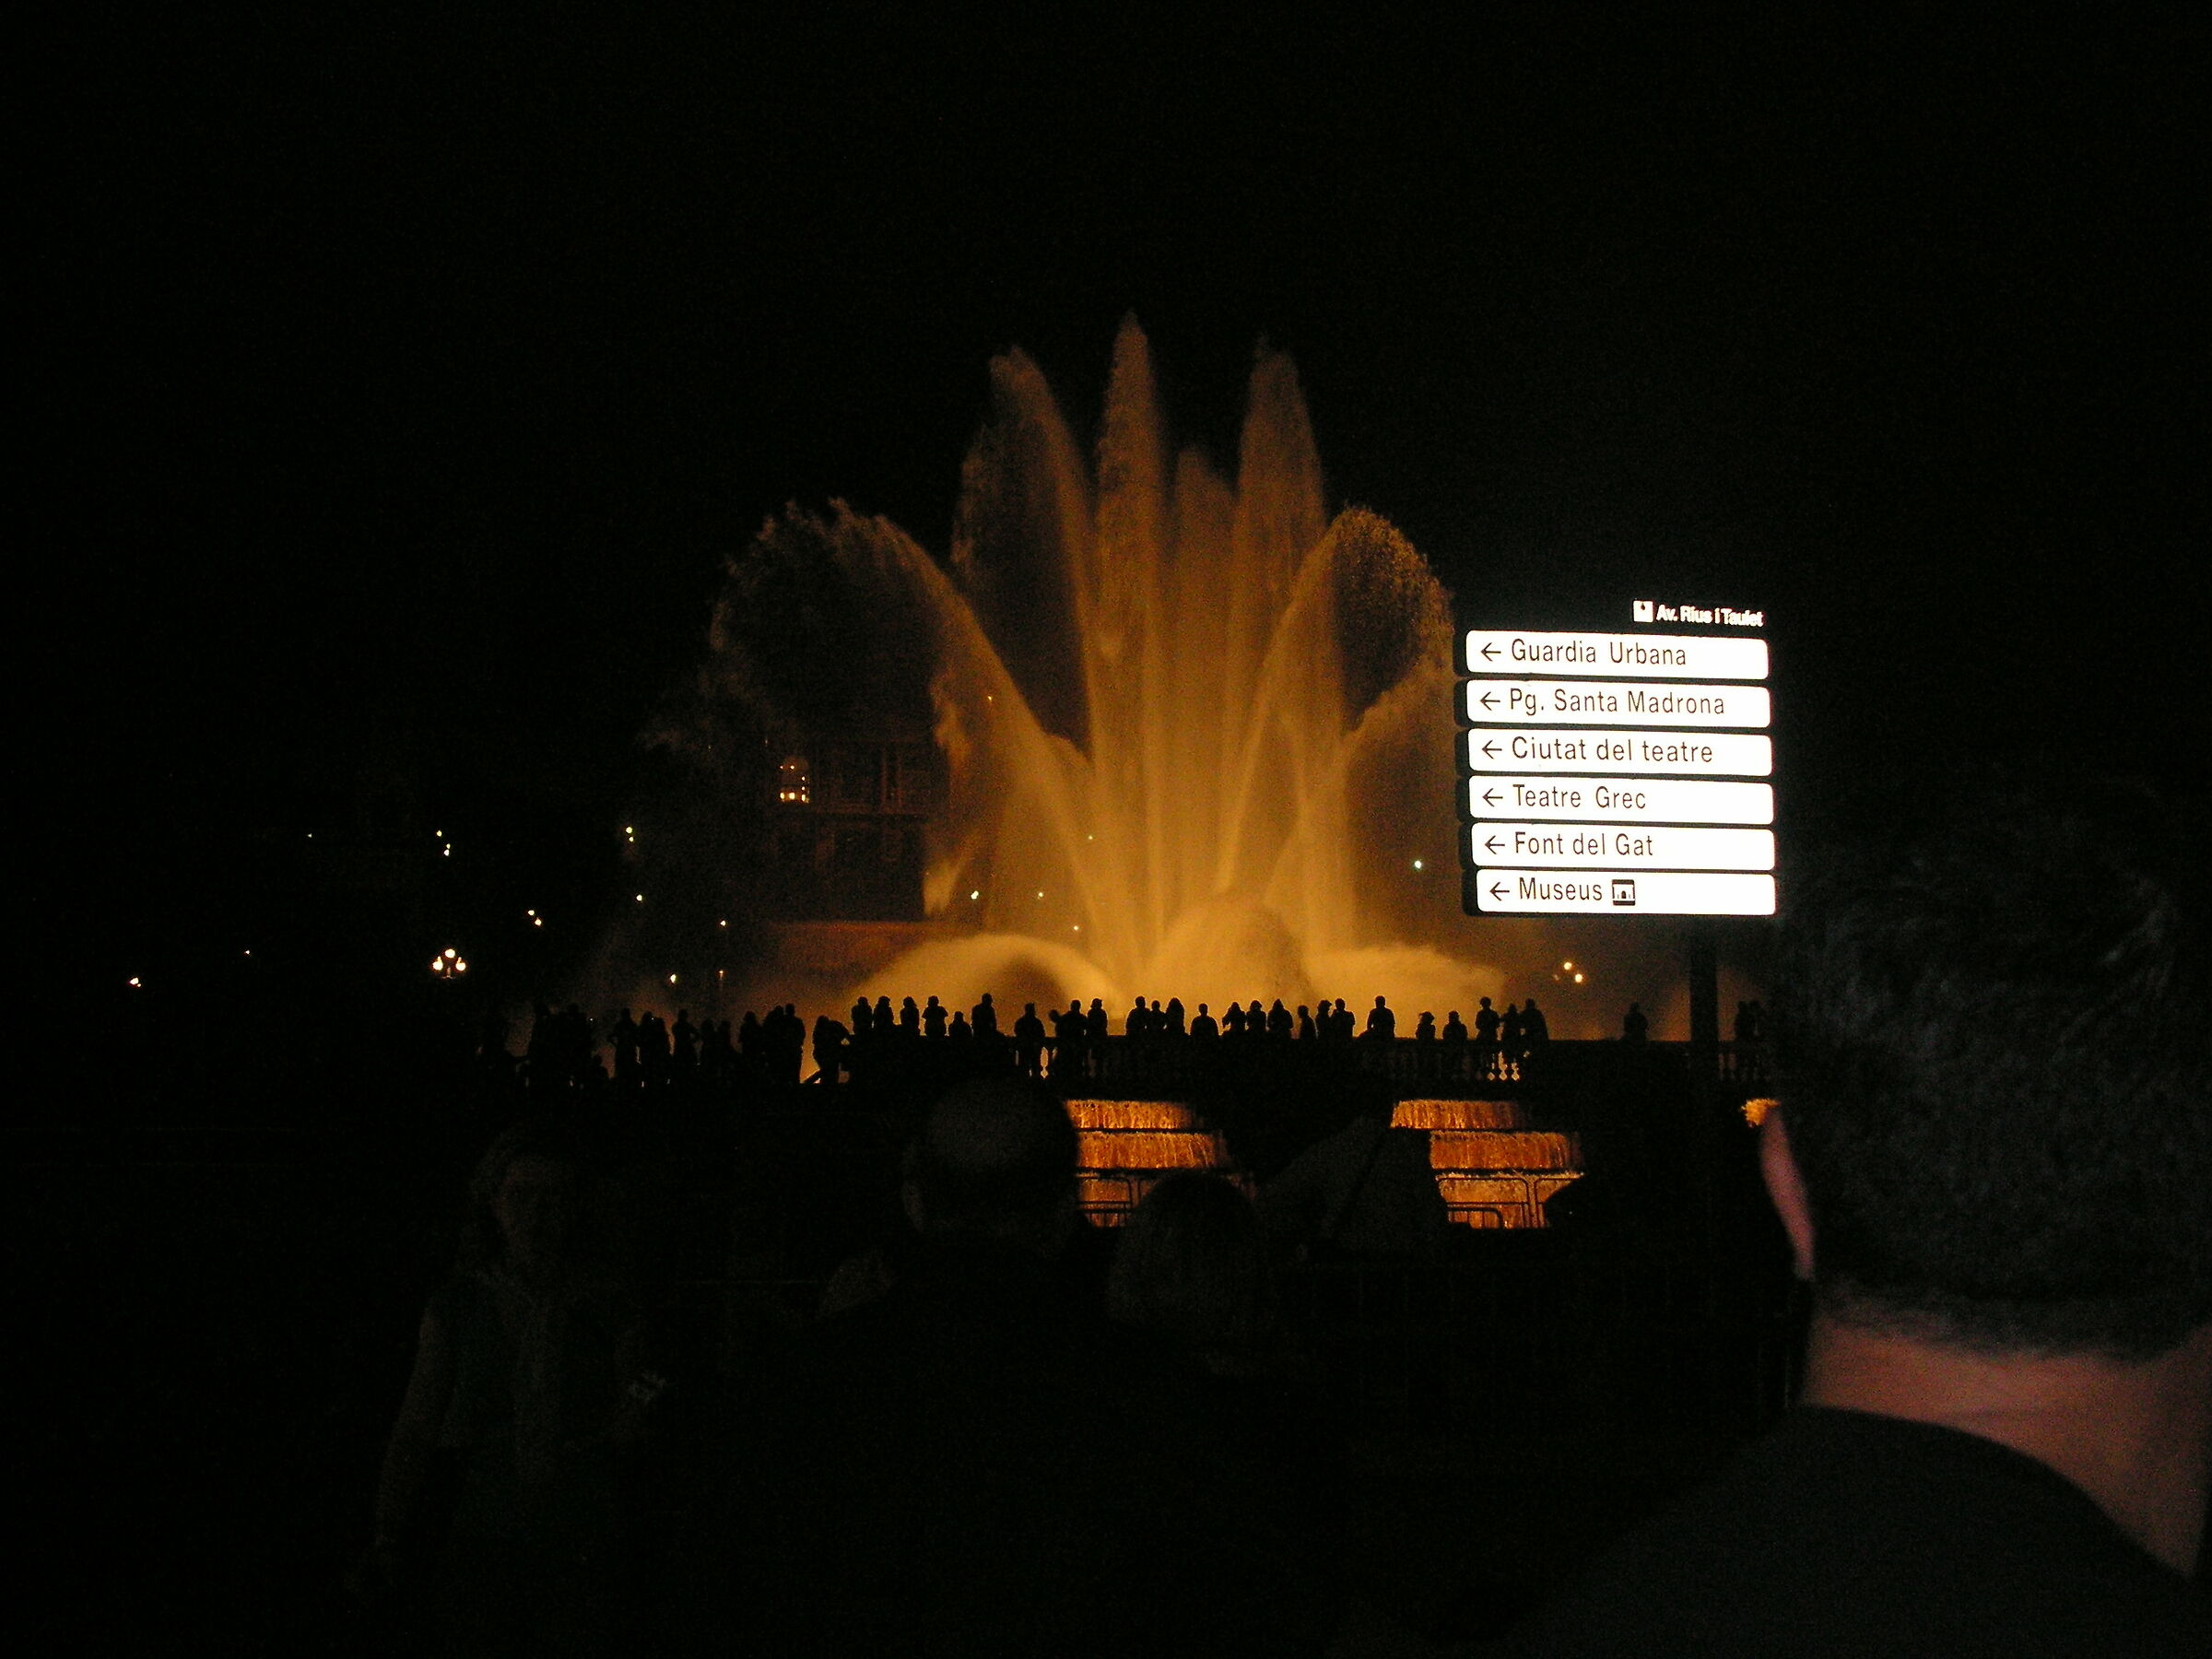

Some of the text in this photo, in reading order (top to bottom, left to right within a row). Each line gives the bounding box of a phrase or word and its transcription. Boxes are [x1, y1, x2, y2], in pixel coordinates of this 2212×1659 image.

[1656, 605, 1678, 621] Av.
[1680, 606, 1712, 623] Rius
[1721, 608, 1763, 627] Taulet
[1511, 638, 1687, 665] Guardia Urbana
[1510, 688, 1724, 716] Pg. Santa Madrona
[1512, 736, 1712, 762] Ciutat del teatre
[1512, 784, 1646, 808] Teatre Grec
[1514, 831, 1653, 856] Font del Gat
[1518, 877, 1603, 900] Museus
